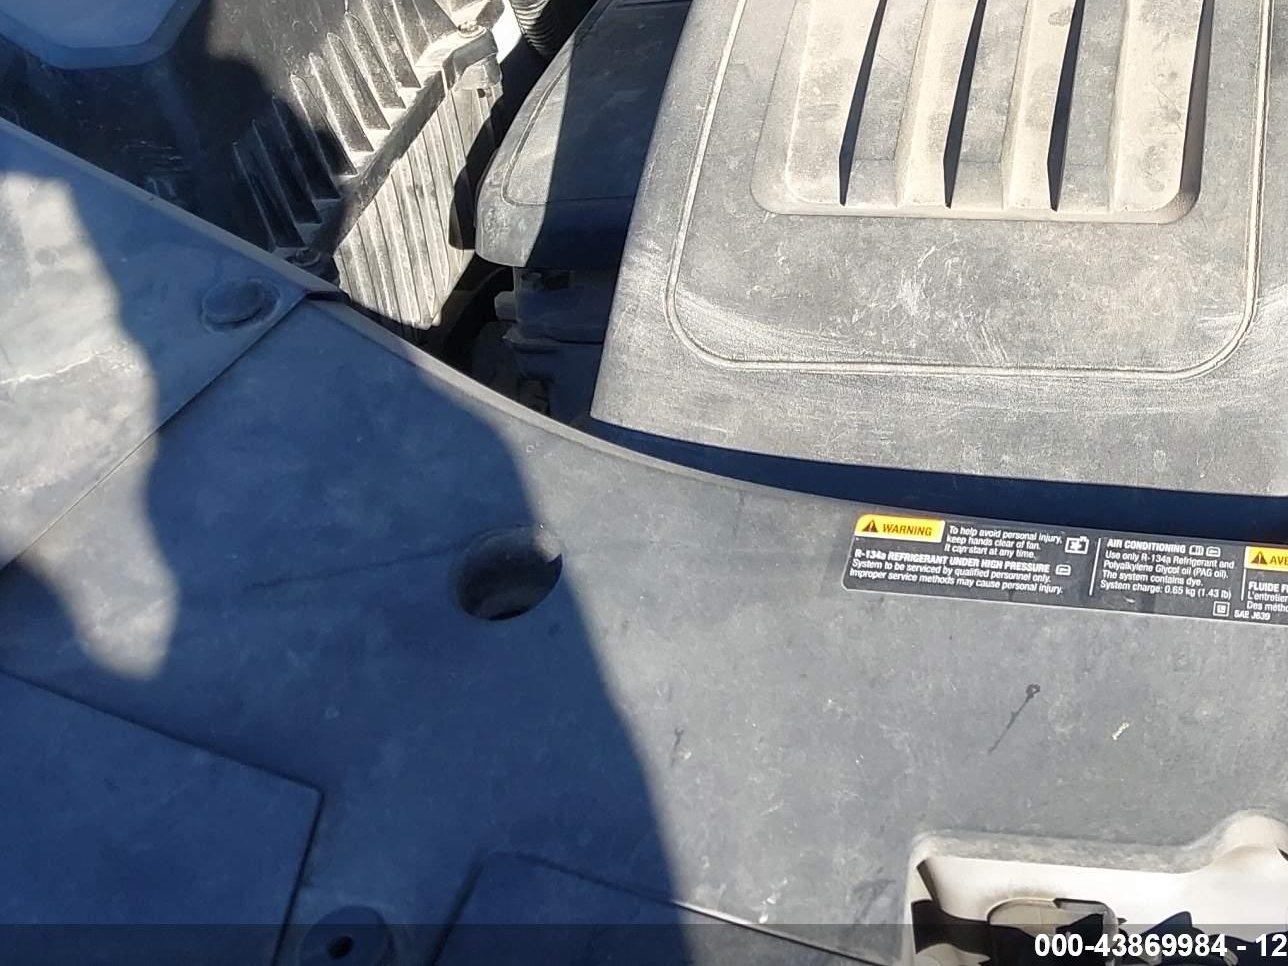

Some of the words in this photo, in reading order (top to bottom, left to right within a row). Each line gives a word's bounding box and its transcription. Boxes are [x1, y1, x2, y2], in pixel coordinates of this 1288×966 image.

[882, 523, 933, 536] WARNING
[949, 525, 959, 534] To
[960, 526, 977, 536] help
[979, 528, 1001, 537] avoid
[1002, 530, 1037, 541] personal
[947, 535, 966, 545] keep
[968, 536, 992, 546] hands
[994, 538, 1013, 548] clear
[1016, 539, 1024, 548] of
[1026, 541, 1041, 550] fan.
[1107, 538, 1122, 548] AIR
[1124, 540, 1186, 554] CONDITIONING
[944, 543, 950, 552] It
[968, 546, 987, 555] start
[999, 549, 1014, 559] any
[1016, 548, 1037, 559] time.
[855, 548, 886, 561] R-134a
[888, 551, 949, 565] REFRIGERANT
[949, 556, 979, 567] UNDER
[981, 558, 1004, 569] HIGH
[1004, 560, 1051, 574] PRESSURE
[1105, 550, 1120, 560] Use
[1122, 552, 1139, 562] only
[1141, 553, 1172, 565] R-134a
[1173, 555, 1217, 568] Refrigerant
[1219, 560, 1234, 570] and
[852, 558, 882, 570] System
[884, 560, 893, 570] to
[894, 562, 905, 571] be
[906, 563, 941, 574] serviced
[942, 566, 953, 576] by
[954, 568, 989, 578] qualified
[990, 570, 1031, 582] personnel
[1032, 574, 1051, 584] only.
[1104, 559, 1154, 572] Polyalkylene
[1155, 564, 1180, 575] Glycol
[1181, 566, 1191, 575] oil
[1193, 567, 1212, 578] (PAG
[1213, 569, 1229, 580] oil).
[849, 568, 887, 580] Improper
[888, 571, 917, 581] service
[919, 573, 954, 584] methods
[956, 577, 974, 588] may
[975, 579, 1001, 588] cause
[1001, 580, 1038, 592] personal
[1038, 583, 1063, 595] injury.
[1103, 570, 1117, 579] The
[1119, 572, 1148, 583] system
[1150, 574, 1184, 585] contains
[1186, 577, 1203, 587] dye.
[1247, 581, 1280, 592] FLUIDE
[1100, 580, 1131, 591] System
[1132, 582, 1163, 594] charge:
[1185, 587, 1195, 597] kg
[1220, 590, 1232, 601] lb)
[1246, 601, 1263, 611] Des
